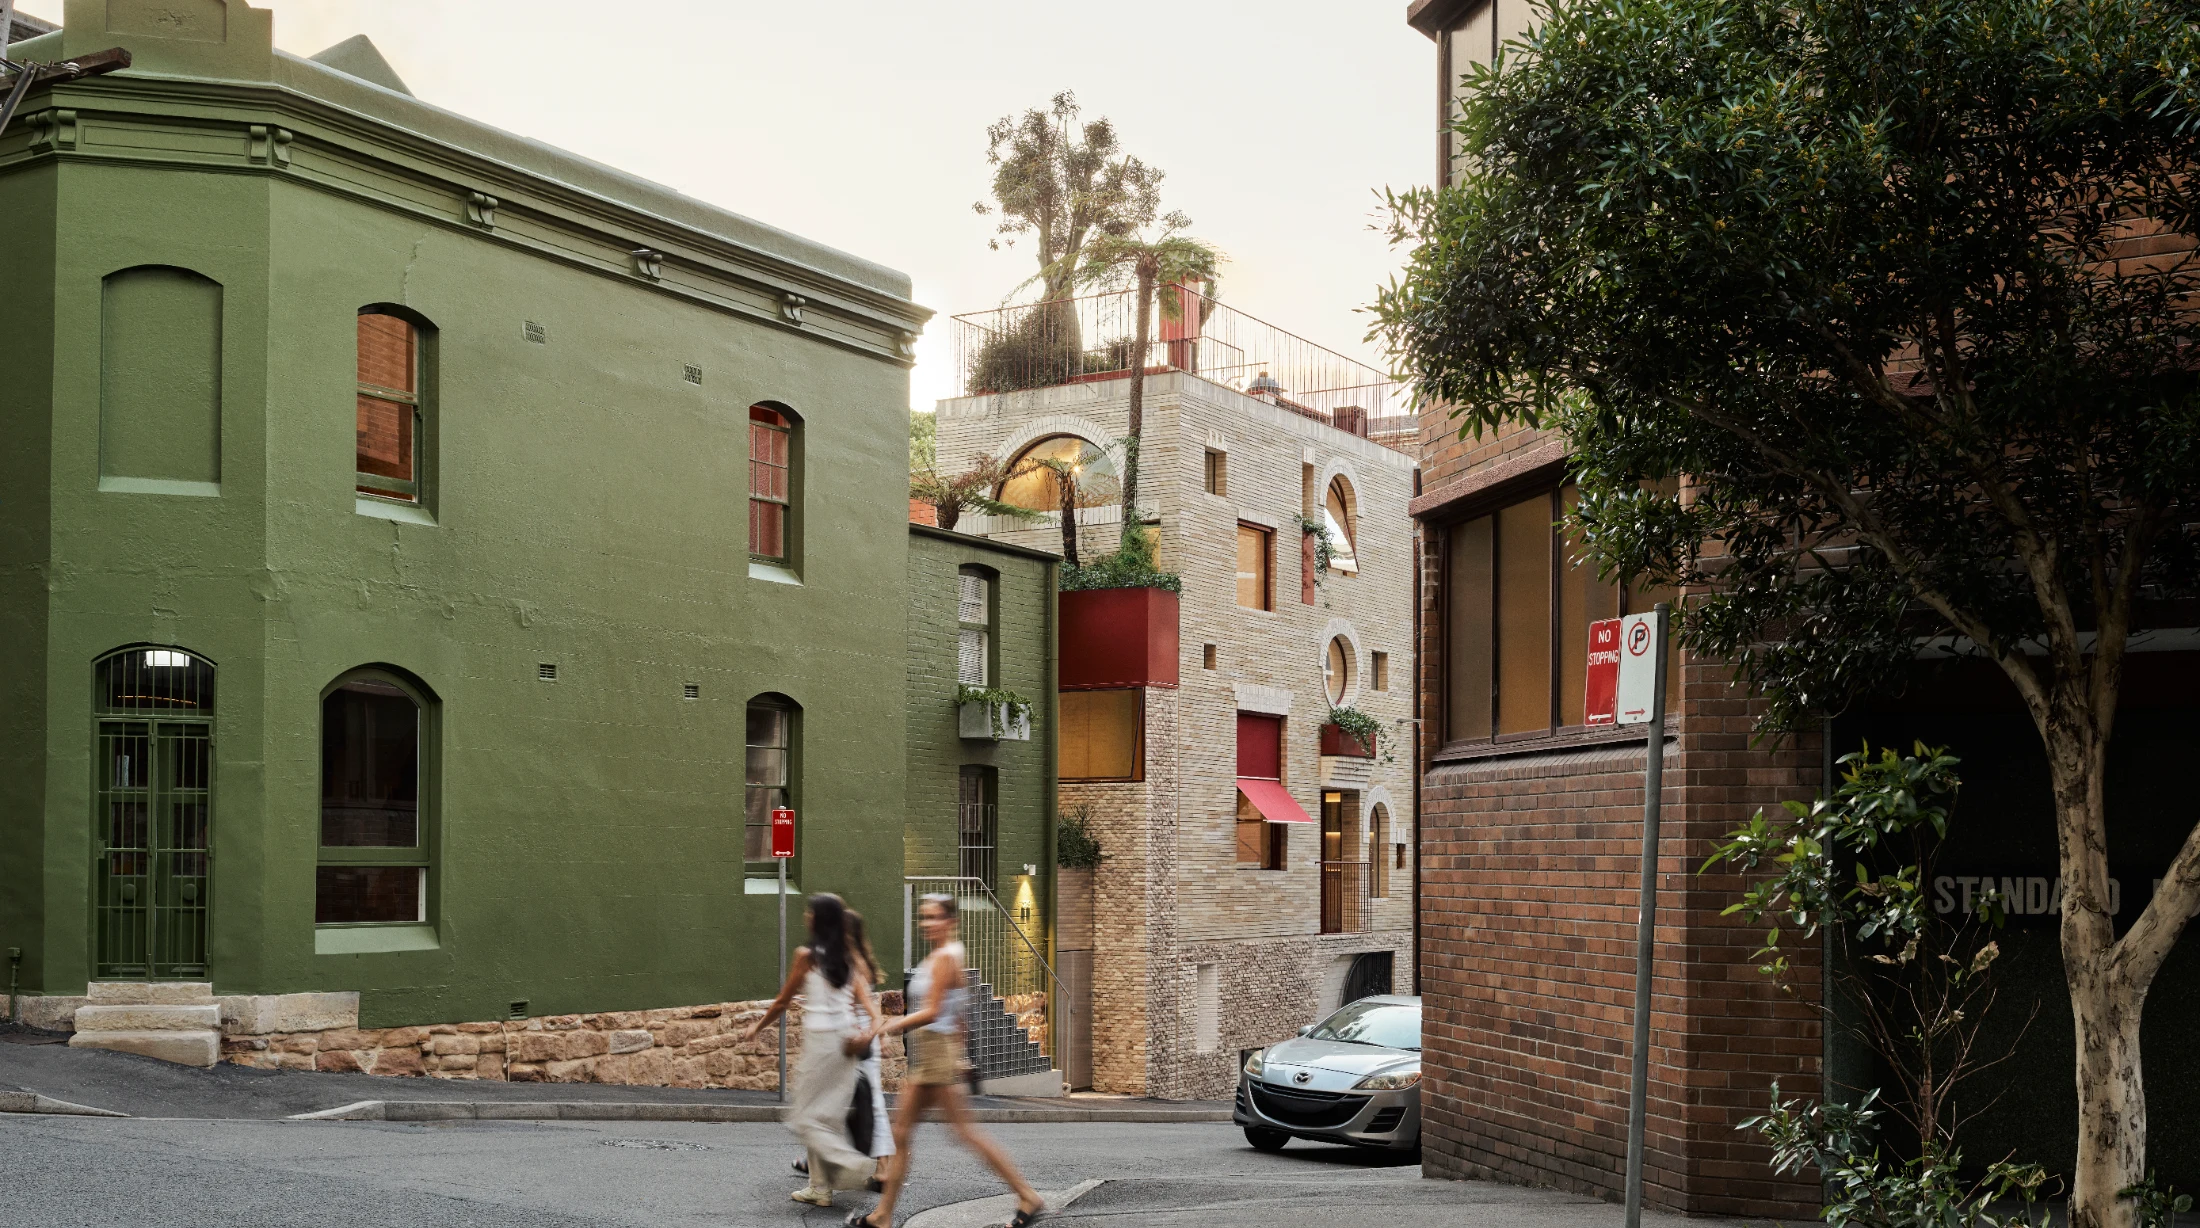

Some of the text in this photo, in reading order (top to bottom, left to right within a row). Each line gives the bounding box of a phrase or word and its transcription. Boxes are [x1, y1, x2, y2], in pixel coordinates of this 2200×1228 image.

[1598, 629, 1611, 643] NO
[1588, 650, 1619, 666] STOPPING
[1934, 876, 2120, 915] STANDAD
